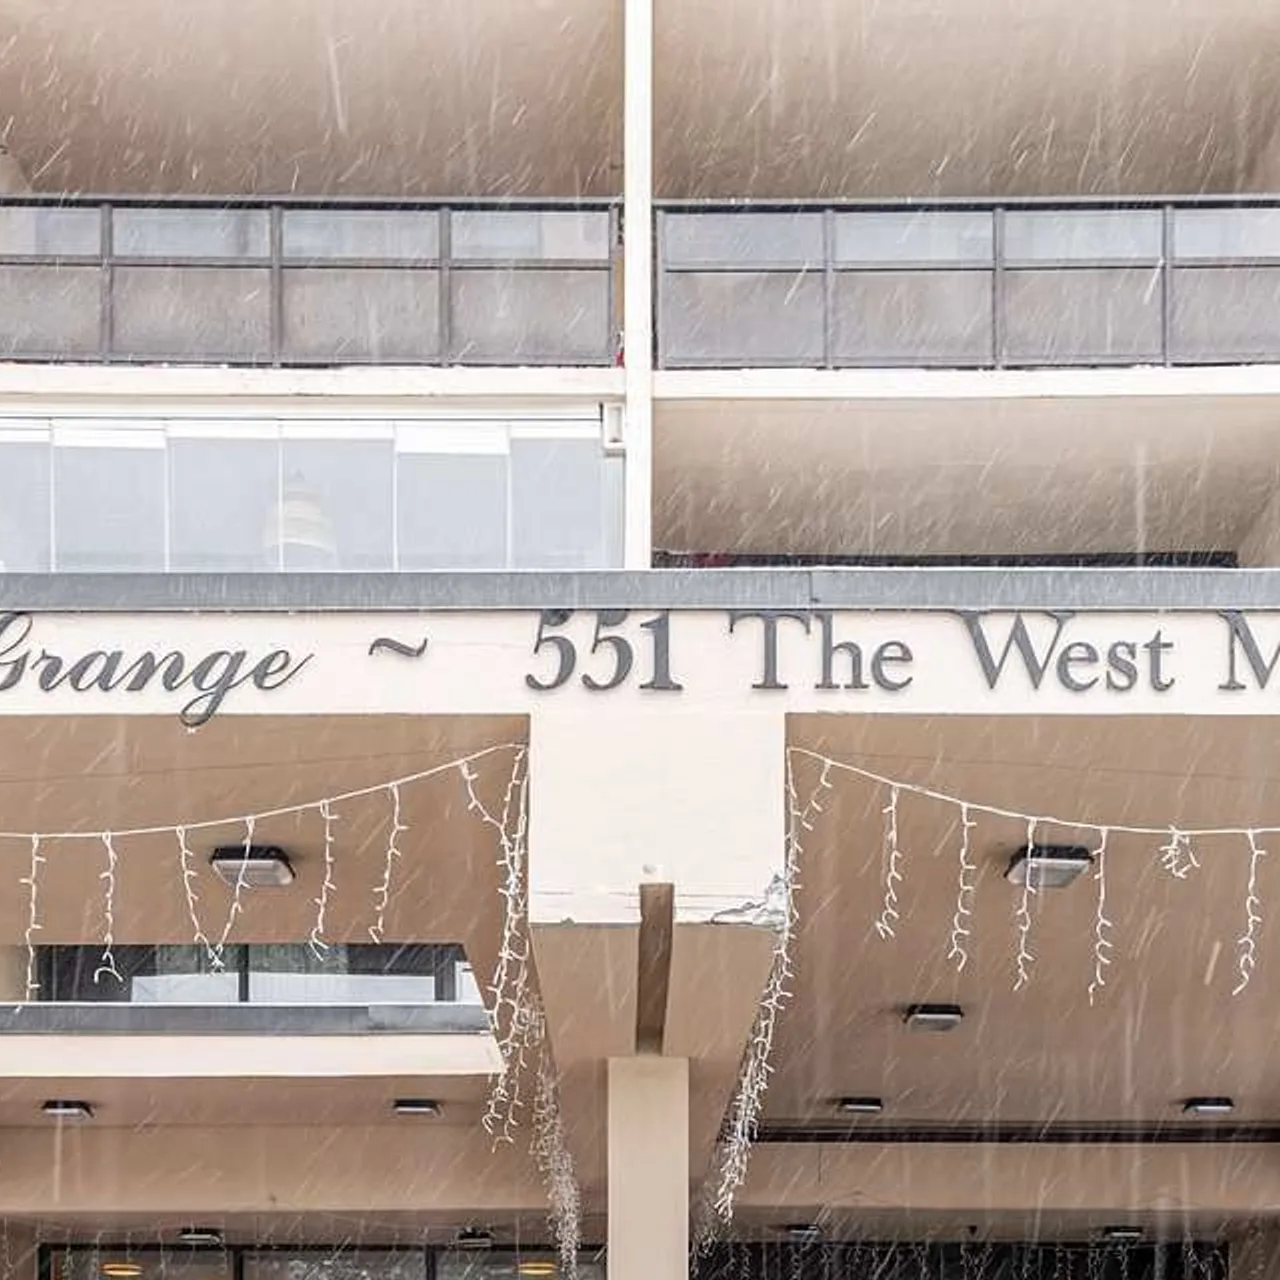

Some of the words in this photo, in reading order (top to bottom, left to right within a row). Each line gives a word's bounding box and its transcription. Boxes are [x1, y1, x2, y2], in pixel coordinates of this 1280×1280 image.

[525, 609, 684, 691] 551
[728, 609, 914, 691] The
[954, 609, 1176, 691] West
